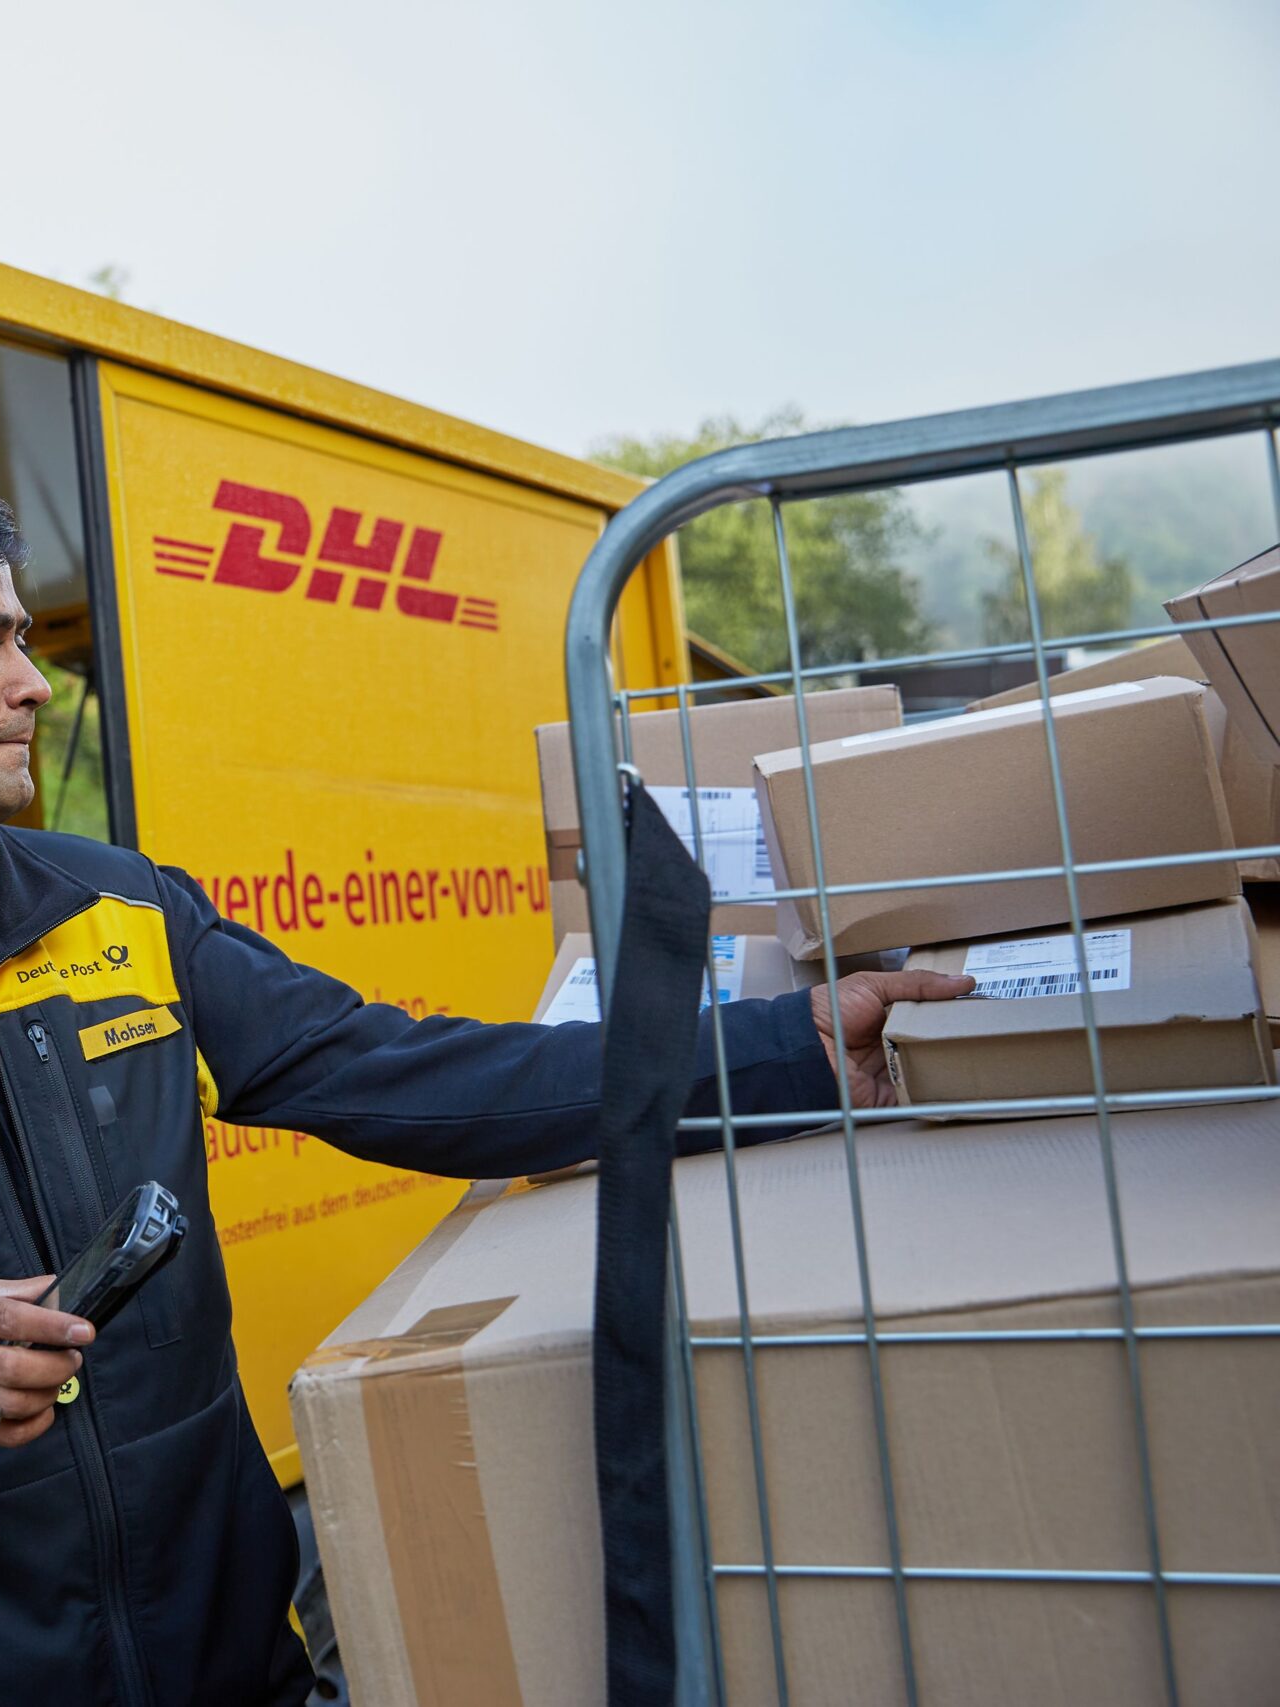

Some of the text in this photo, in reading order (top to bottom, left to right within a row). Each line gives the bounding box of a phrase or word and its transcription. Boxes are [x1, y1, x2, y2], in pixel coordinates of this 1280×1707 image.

[211, 479, 460, 623] DHL
[16, 960, 103, 983] Deute Post
[218, 1173, 417, 1247] ostenfrei aus dem deutschen
